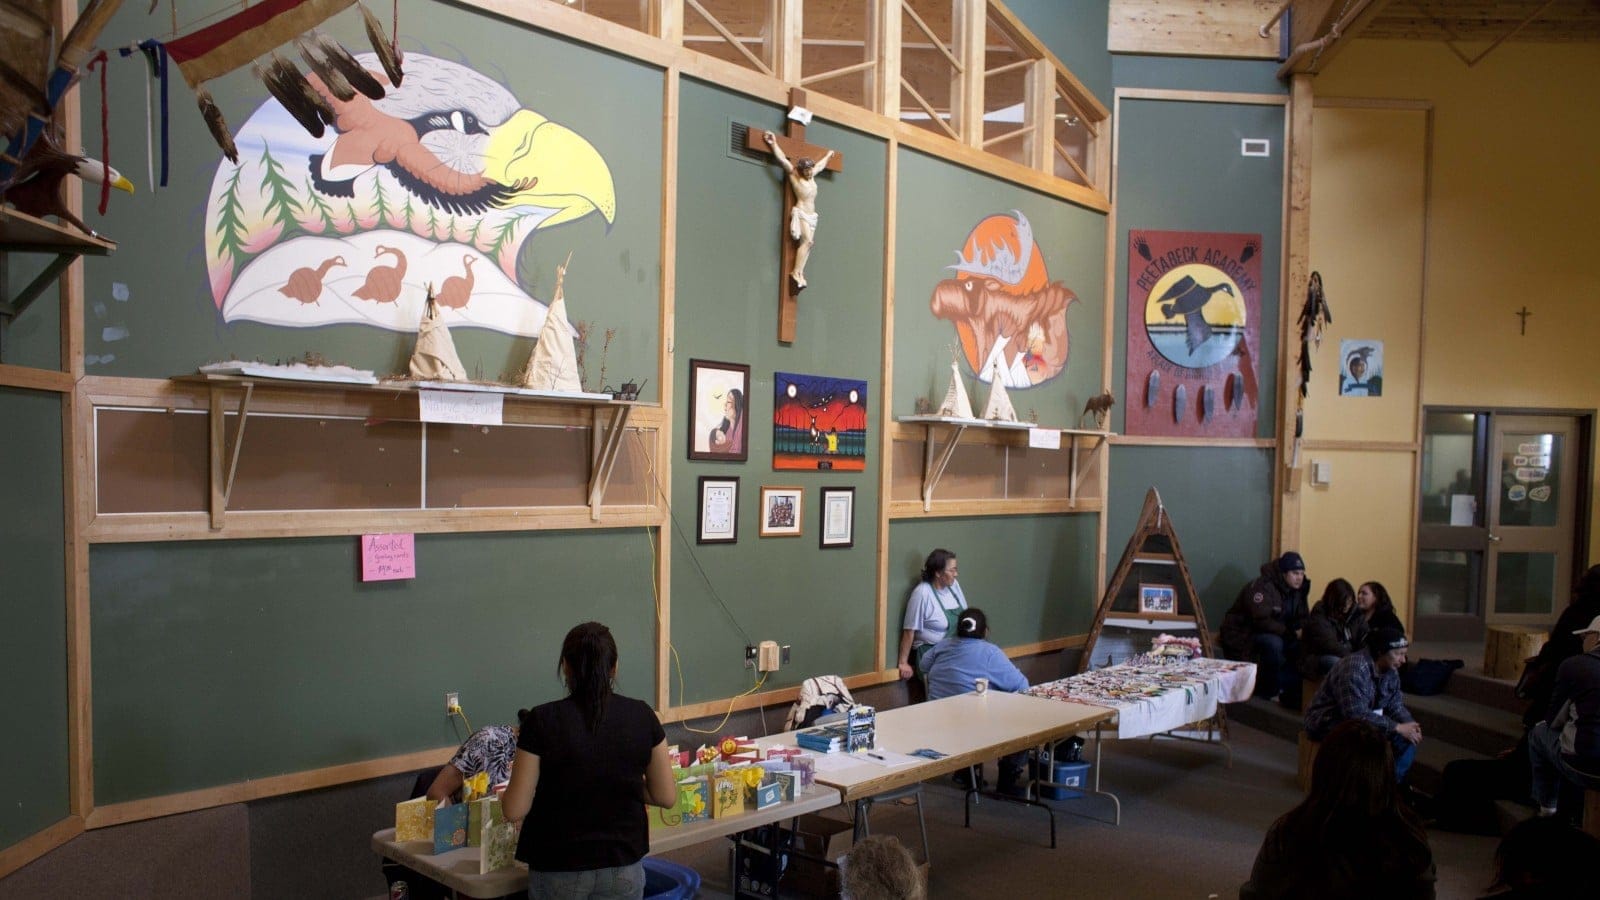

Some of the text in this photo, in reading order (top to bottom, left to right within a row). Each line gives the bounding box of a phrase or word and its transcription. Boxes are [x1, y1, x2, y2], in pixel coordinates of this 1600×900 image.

[1136, 246, 1256, 292] PEETABECK ACADEMY
[368, 536, 406, 552] Assorted
